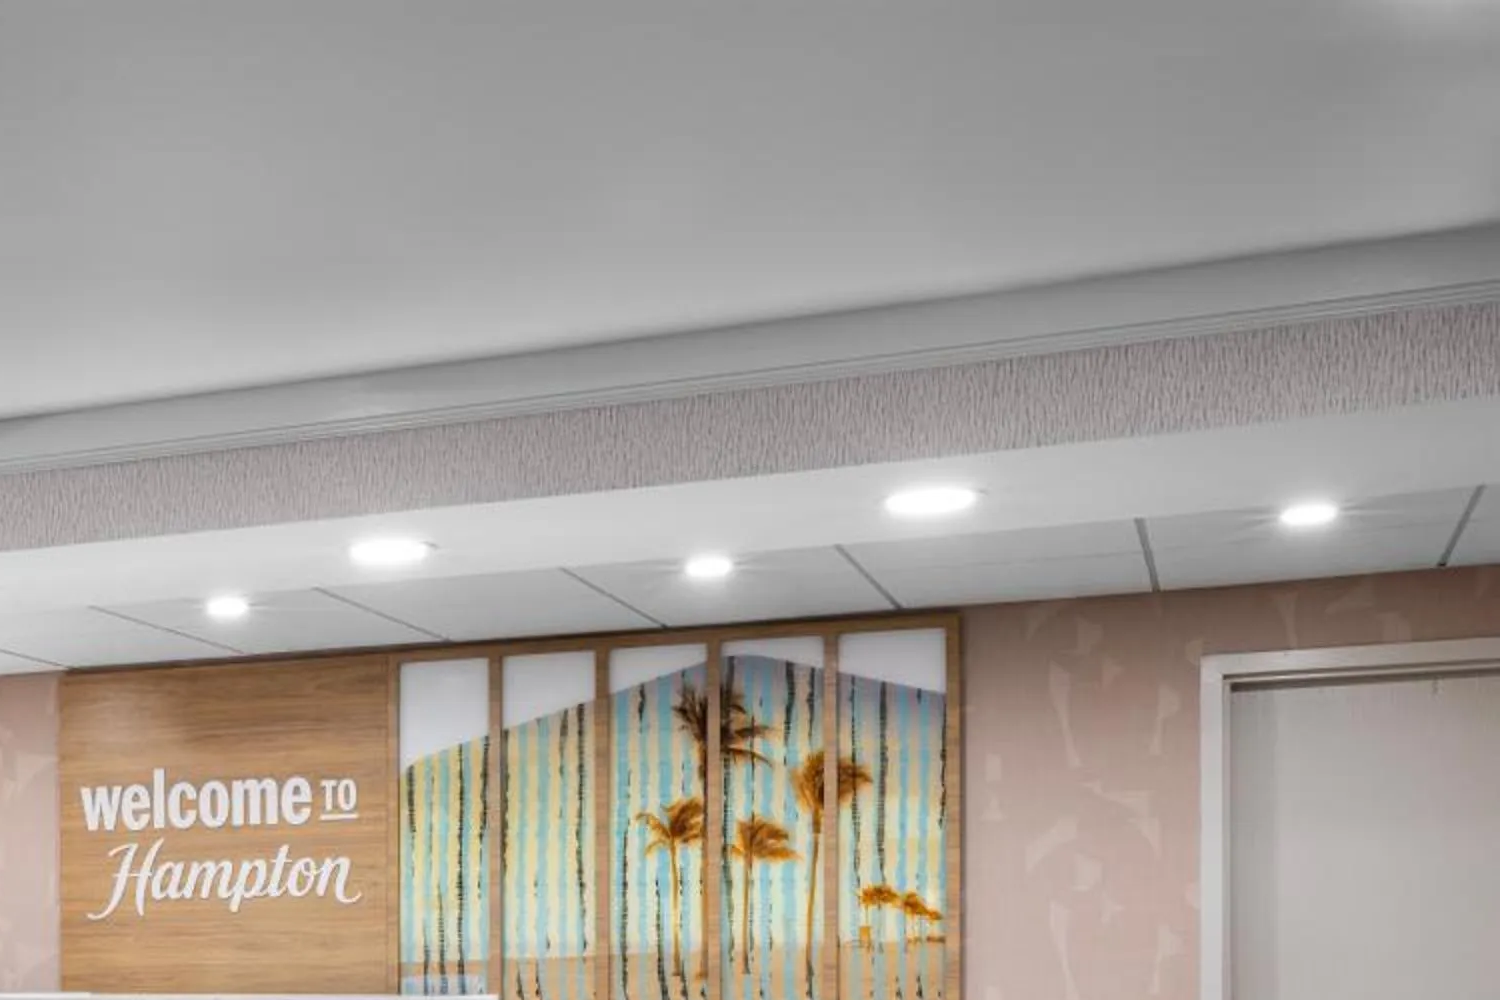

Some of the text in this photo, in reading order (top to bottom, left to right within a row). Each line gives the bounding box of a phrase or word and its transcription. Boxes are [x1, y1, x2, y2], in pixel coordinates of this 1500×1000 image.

[80, 768, 359, 832] welcome TO
[87, 837, 362, 921] Hampton
